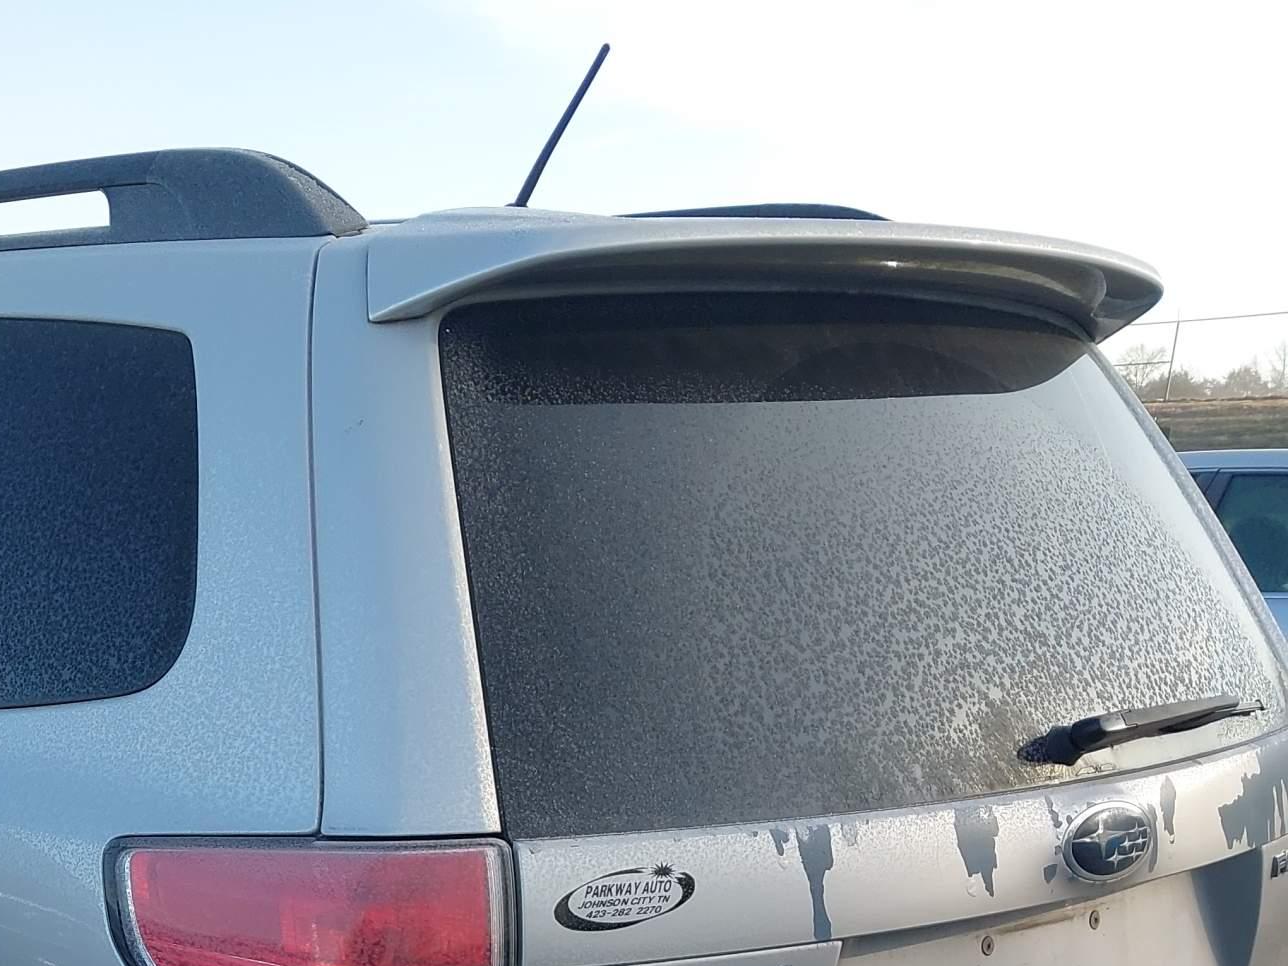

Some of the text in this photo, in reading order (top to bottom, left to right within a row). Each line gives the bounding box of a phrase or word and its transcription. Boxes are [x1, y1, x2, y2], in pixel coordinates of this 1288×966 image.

[584, 880, 672, 898] PARKWAY AUTO
[577, 895, 671, 910] JOHNSON CITY TN
[585, 905, 663, 919] 423-282 2270
